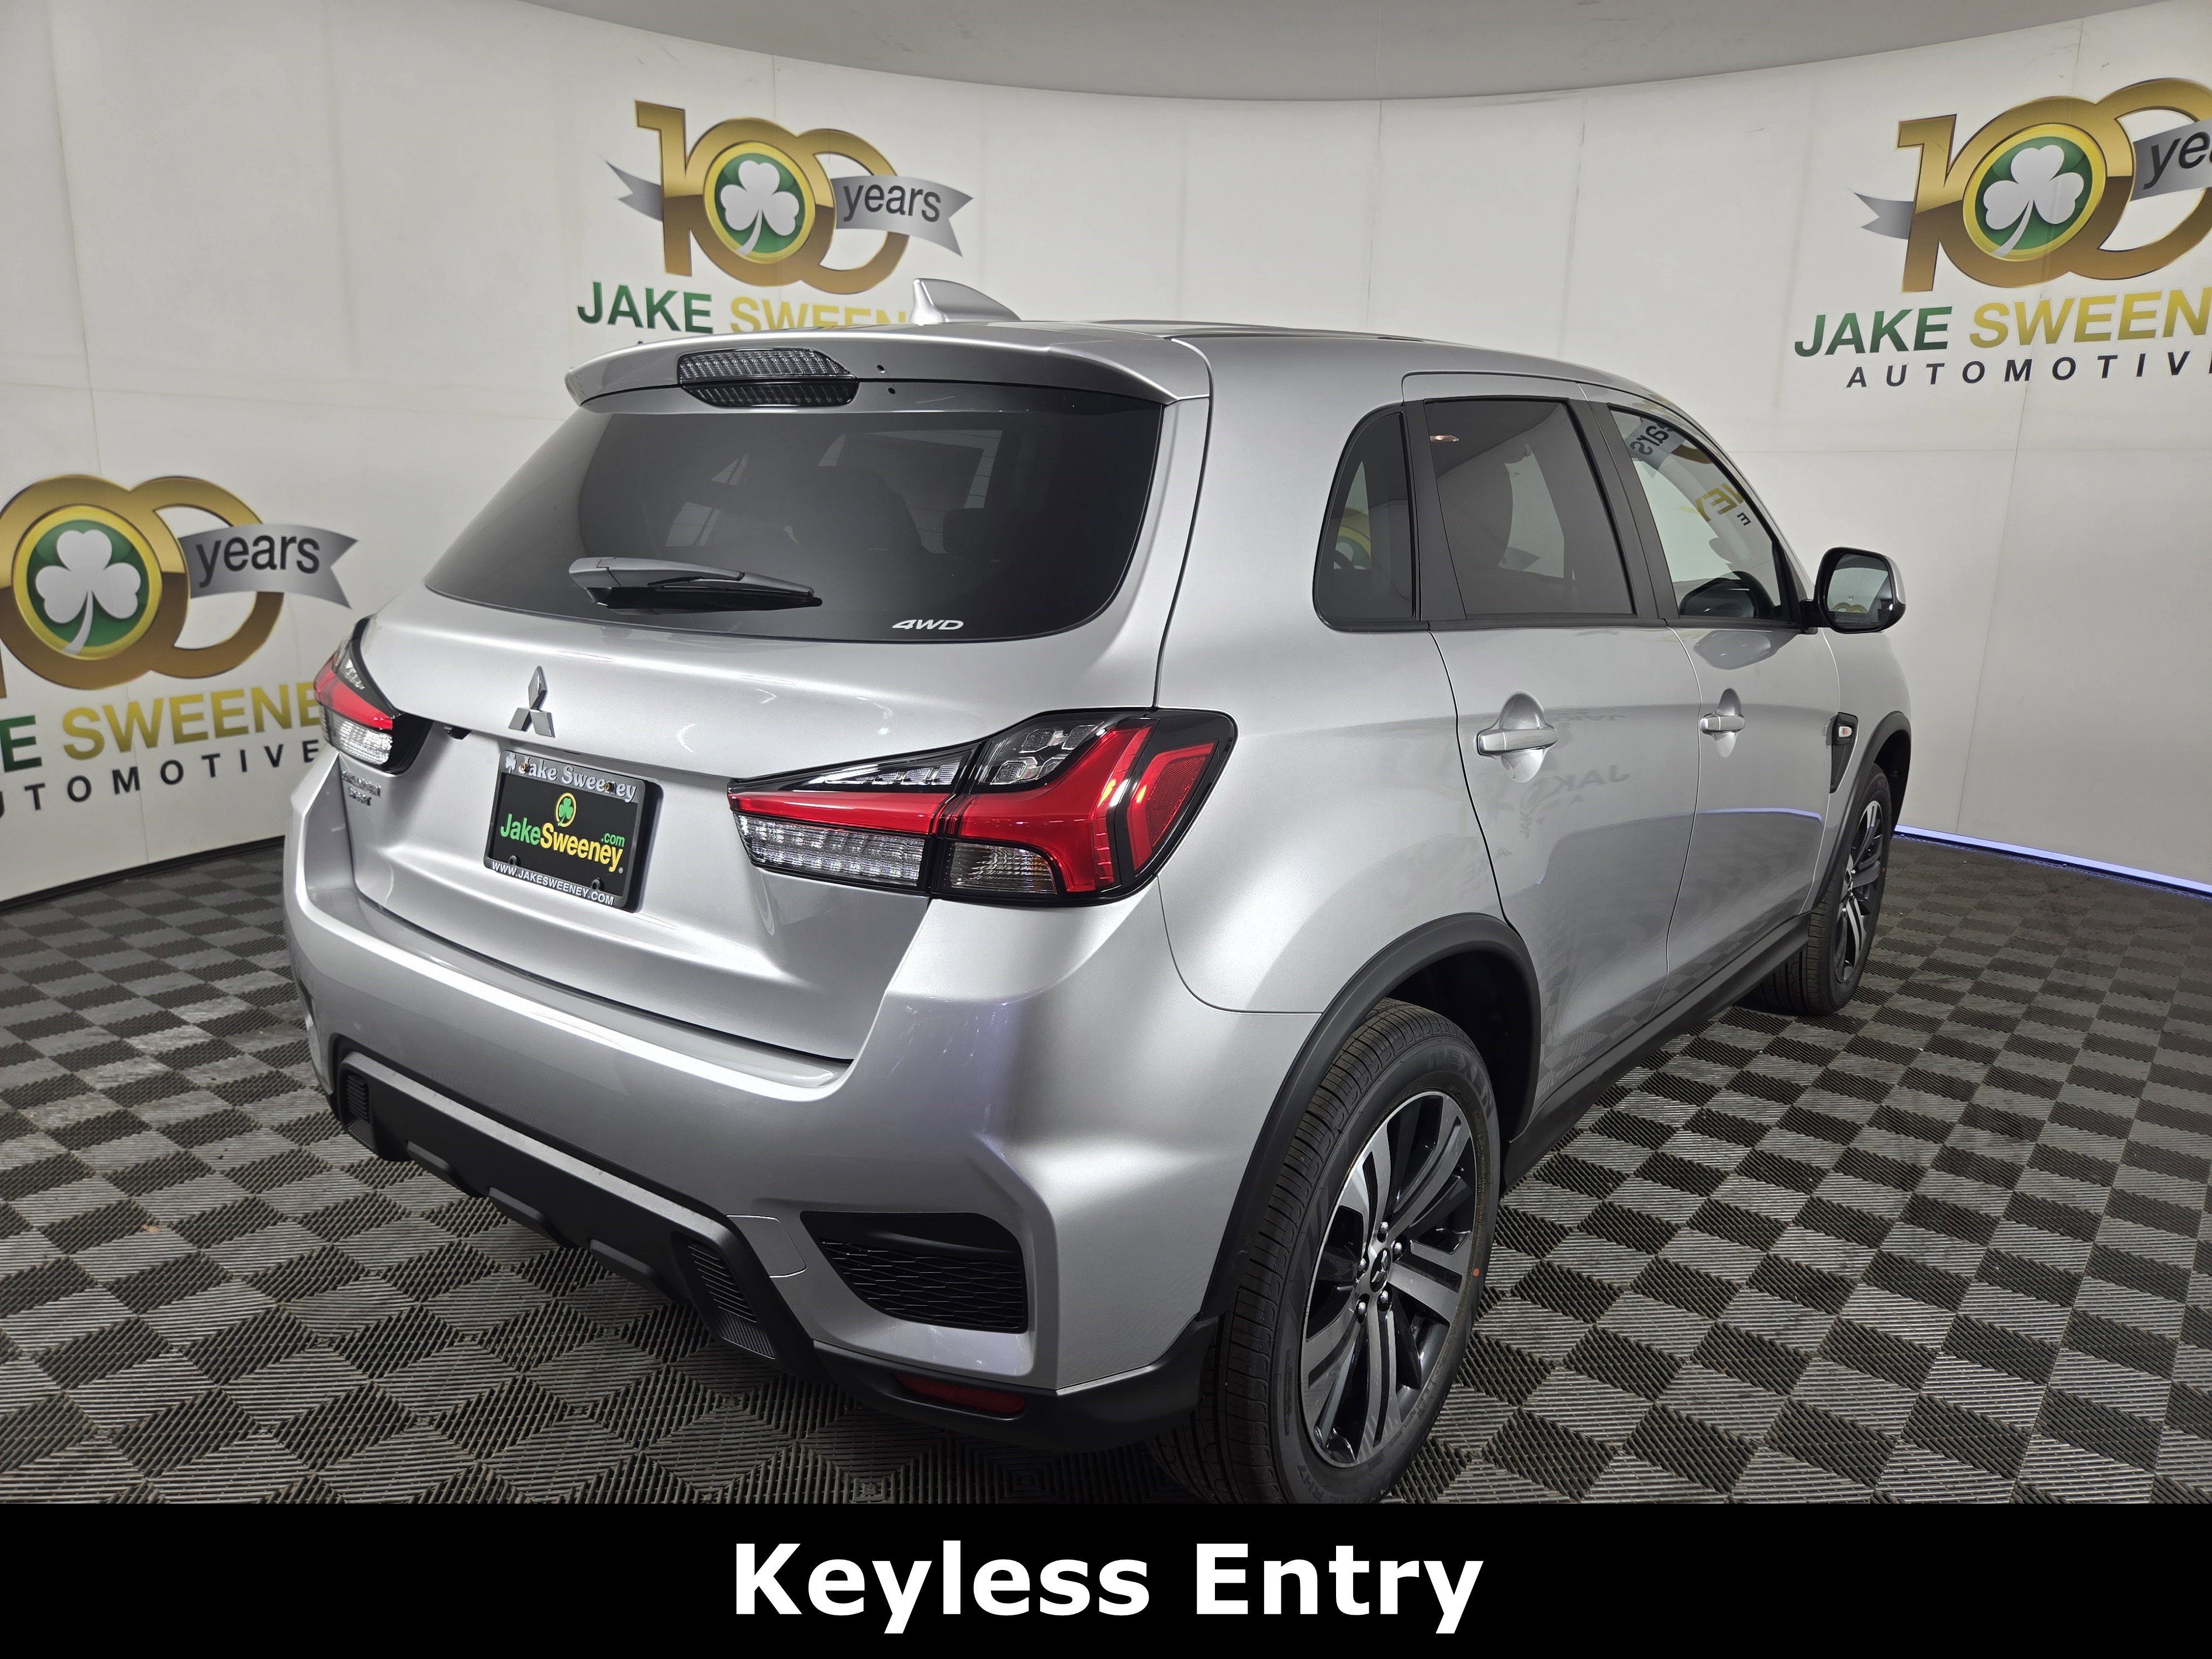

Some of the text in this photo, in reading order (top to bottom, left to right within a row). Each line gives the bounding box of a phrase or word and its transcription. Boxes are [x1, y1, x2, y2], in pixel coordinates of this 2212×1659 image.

[2143, 132, 2212, 189] ye
[843, 183, 941, 222] years
[577, 281, 713, 334] JAKE
[1794, 286, 2212, 357] JAKE SWEEN
[1845, 351, 2212, 388] AUTOMOTIV
[0, 474, 285, 698] 00
[196, 534, 320, 588] years
[892, 619, 964, 630] 4WD
[500, 813, 623, 873] JakeSweeney
[601, 832, 625, 847] .com
[492, 860, 615, 906] WWW.JAKESWEENEY.COM
